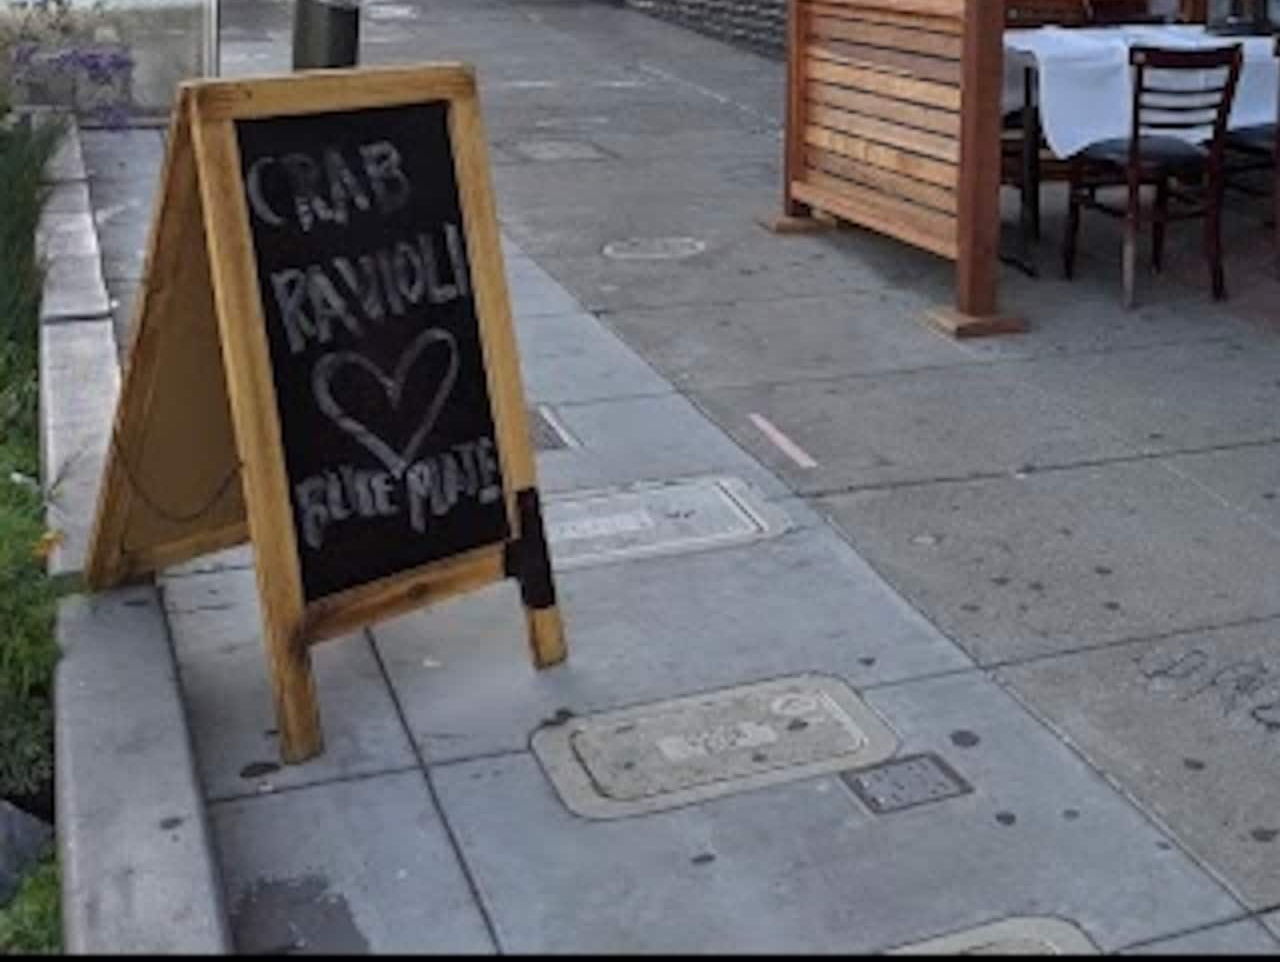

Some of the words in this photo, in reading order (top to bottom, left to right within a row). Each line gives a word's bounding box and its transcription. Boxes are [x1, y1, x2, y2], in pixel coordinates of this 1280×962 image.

[246, 140, 412, 233] CRAB
[270, 223, 469, 354] RAVIOLI
[294, 465, 399, 551] BLUE
